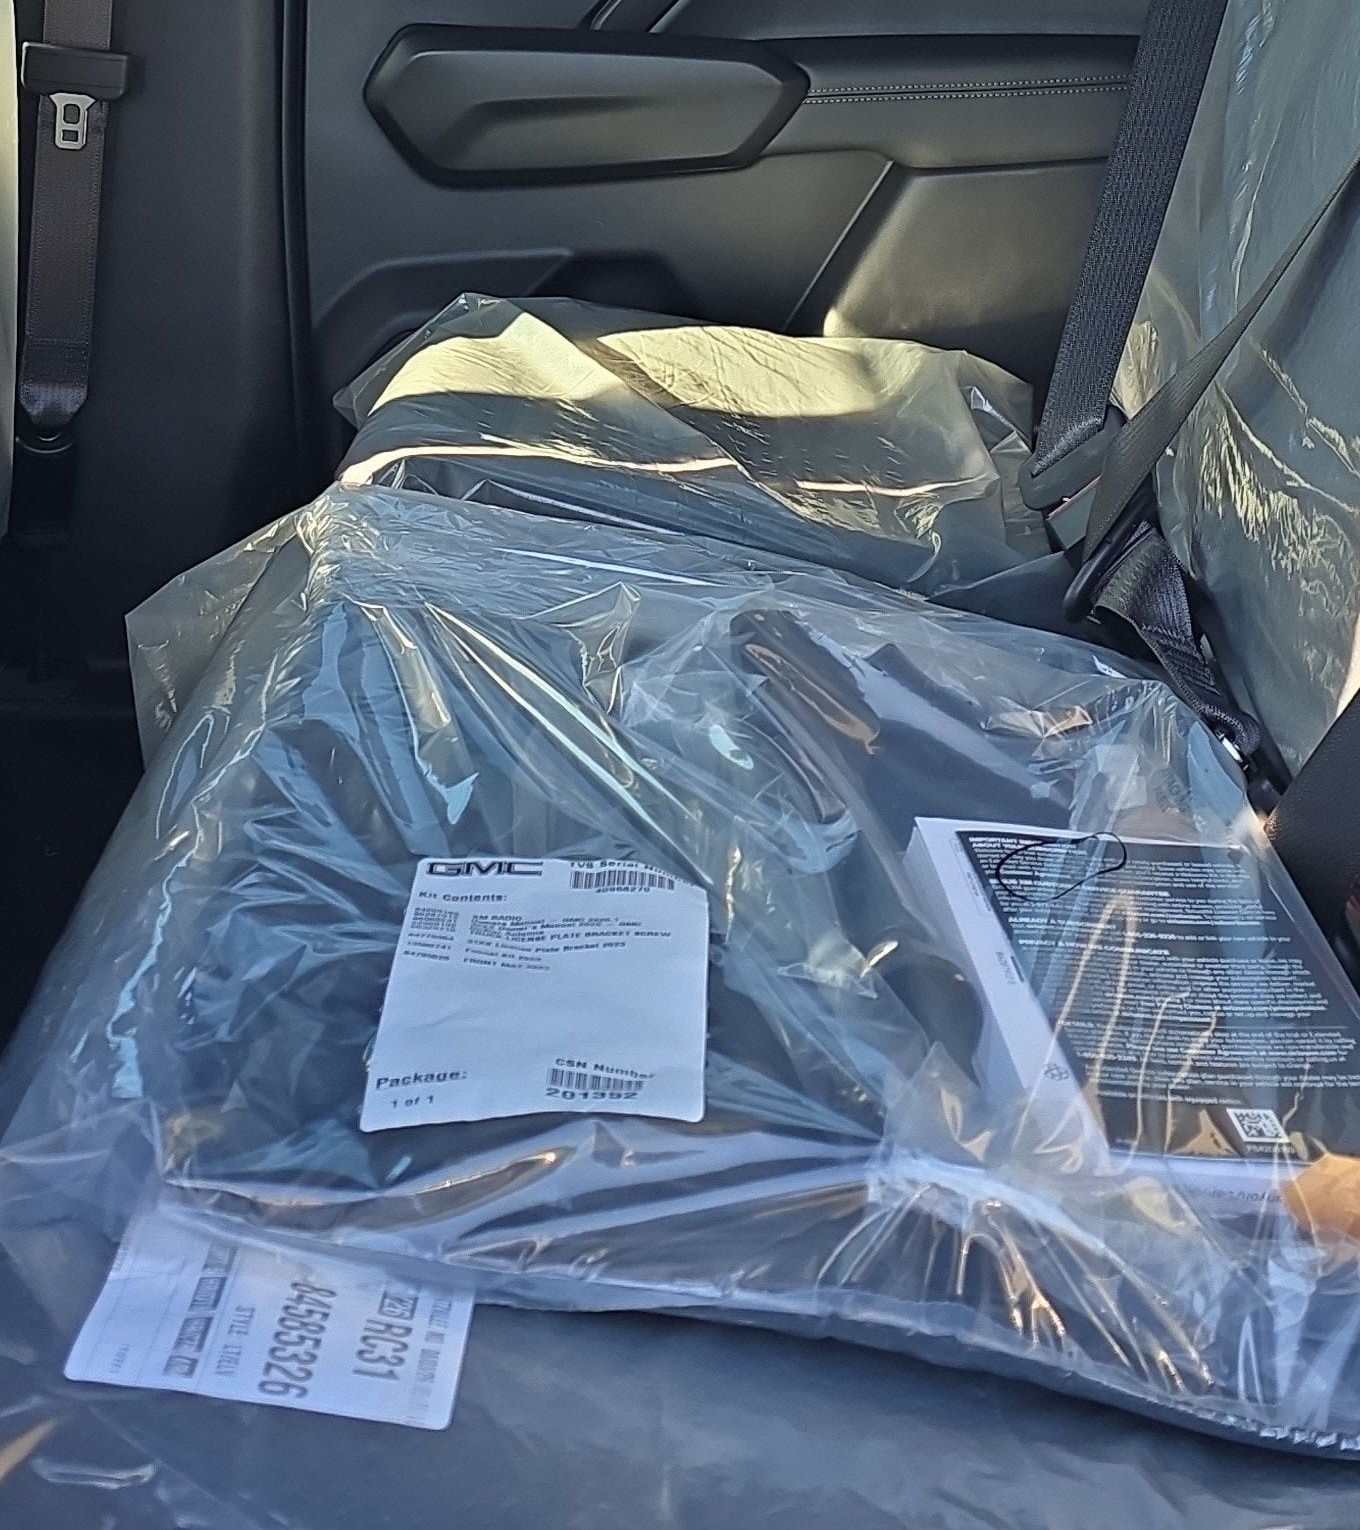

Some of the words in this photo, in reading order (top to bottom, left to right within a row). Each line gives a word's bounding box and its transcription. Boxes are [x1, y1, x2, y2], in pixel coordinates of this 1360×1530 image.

[426, 860, 544, 877] GMC
[418, 891, 438, 899] Kit
[442, 894, 508, 902] Contents:
[550, 932, 582, 941] PLATE
[584, 930, 630, 938] BRACKET
[555, 1058, 587, 1069] CSN
[375, 1071, 467, 1089] Package:
[545, 1087, 638, 1100] 201352
[404, 1096, 420, 1107] of
[227, 1305, 257, 1337] STYLE
[256, 1281, 339, 1400] 84585326
[352, 1318, 414, 1382] RC31
